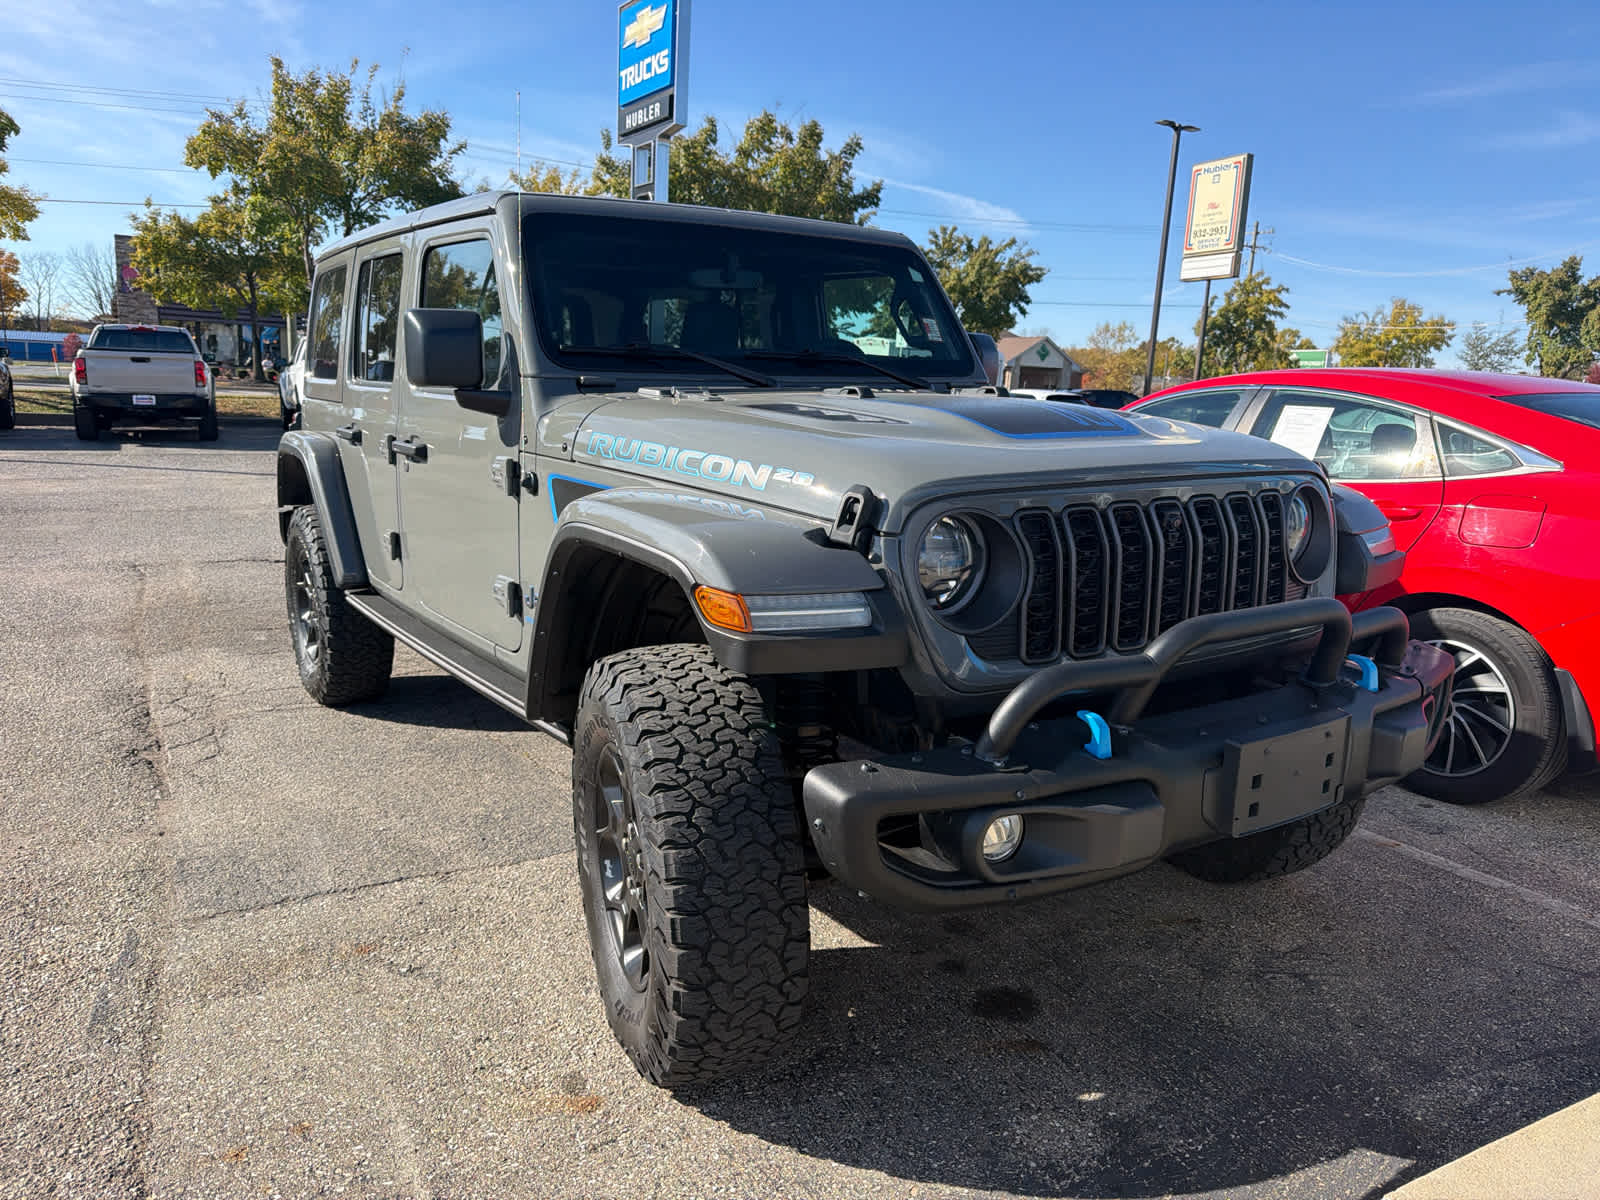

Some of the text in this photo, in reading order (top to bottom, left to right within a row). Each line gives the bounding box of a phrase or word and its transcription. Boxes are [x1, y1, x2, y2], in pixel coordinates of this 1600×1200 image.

[620, 48, 669, 91] TRUCKS
[625, 102, 661, 129] HUBLER
[587, 431, 773, 491] RUBICON
